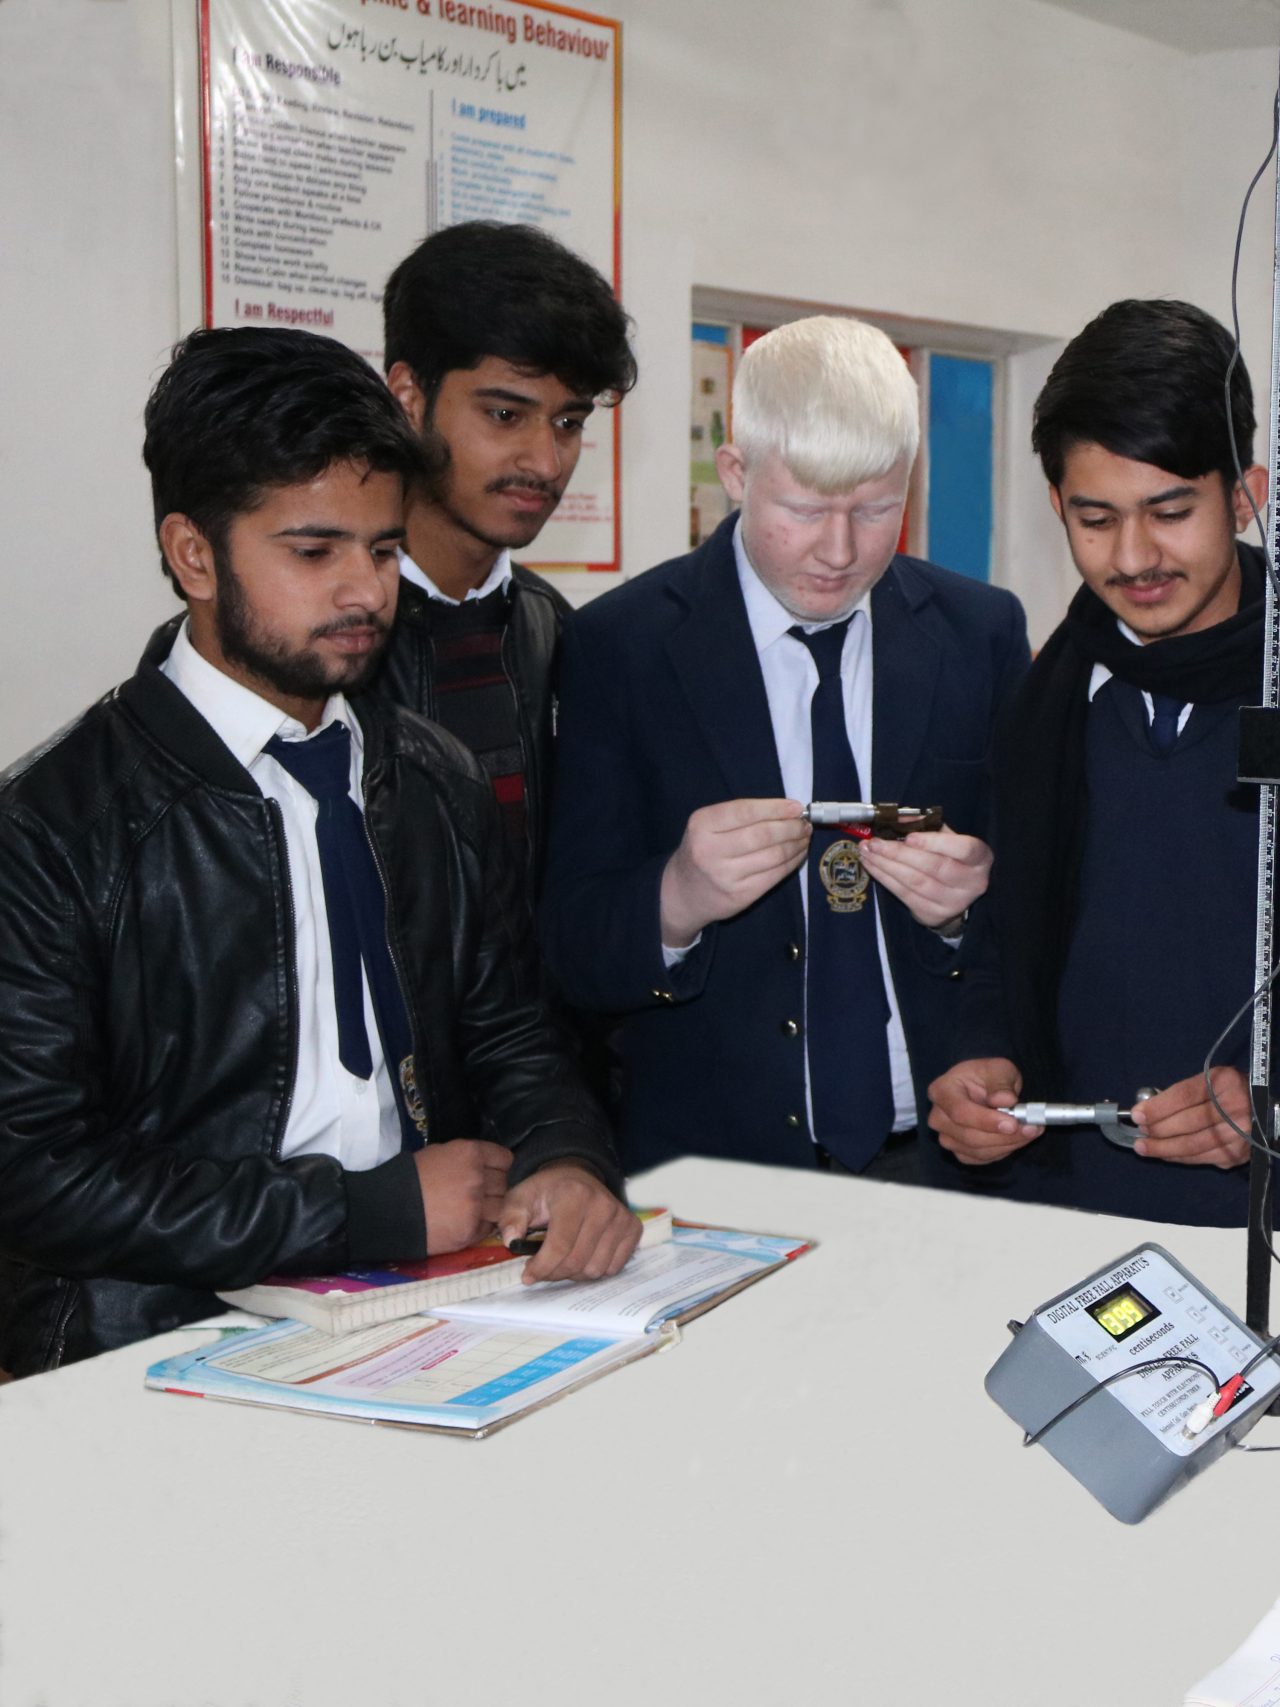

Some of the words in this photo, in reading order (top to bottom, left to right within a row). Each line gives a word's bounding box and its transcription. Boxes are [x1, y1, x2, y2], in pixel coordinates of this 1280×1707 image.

[439, 0, 517, 43] learning
[523, 14, 609, 60] Behaviour
[452, 97, 456, 113] I
[459, 103, 475, 118] am
[479, 106, 527, 129] prepared
[235, 299, 239, 316] I
[244, 303, 263, 317] am
[268, 301, 334, 326] Respectful
[1047, 1300, 1079, 1324] DIGITAL
[1075, 1289, 1095, 1307] FREE
[1093, 1280, 1113, 1298] FALL
[1110, 1257, 1150, 1287] APPARATUS
[1129, 1322, 1175, 1356] centiseconds
[1162, 1344, 1183, 1358] FREE
[1180, 1333, 1199, 1349] FALL
